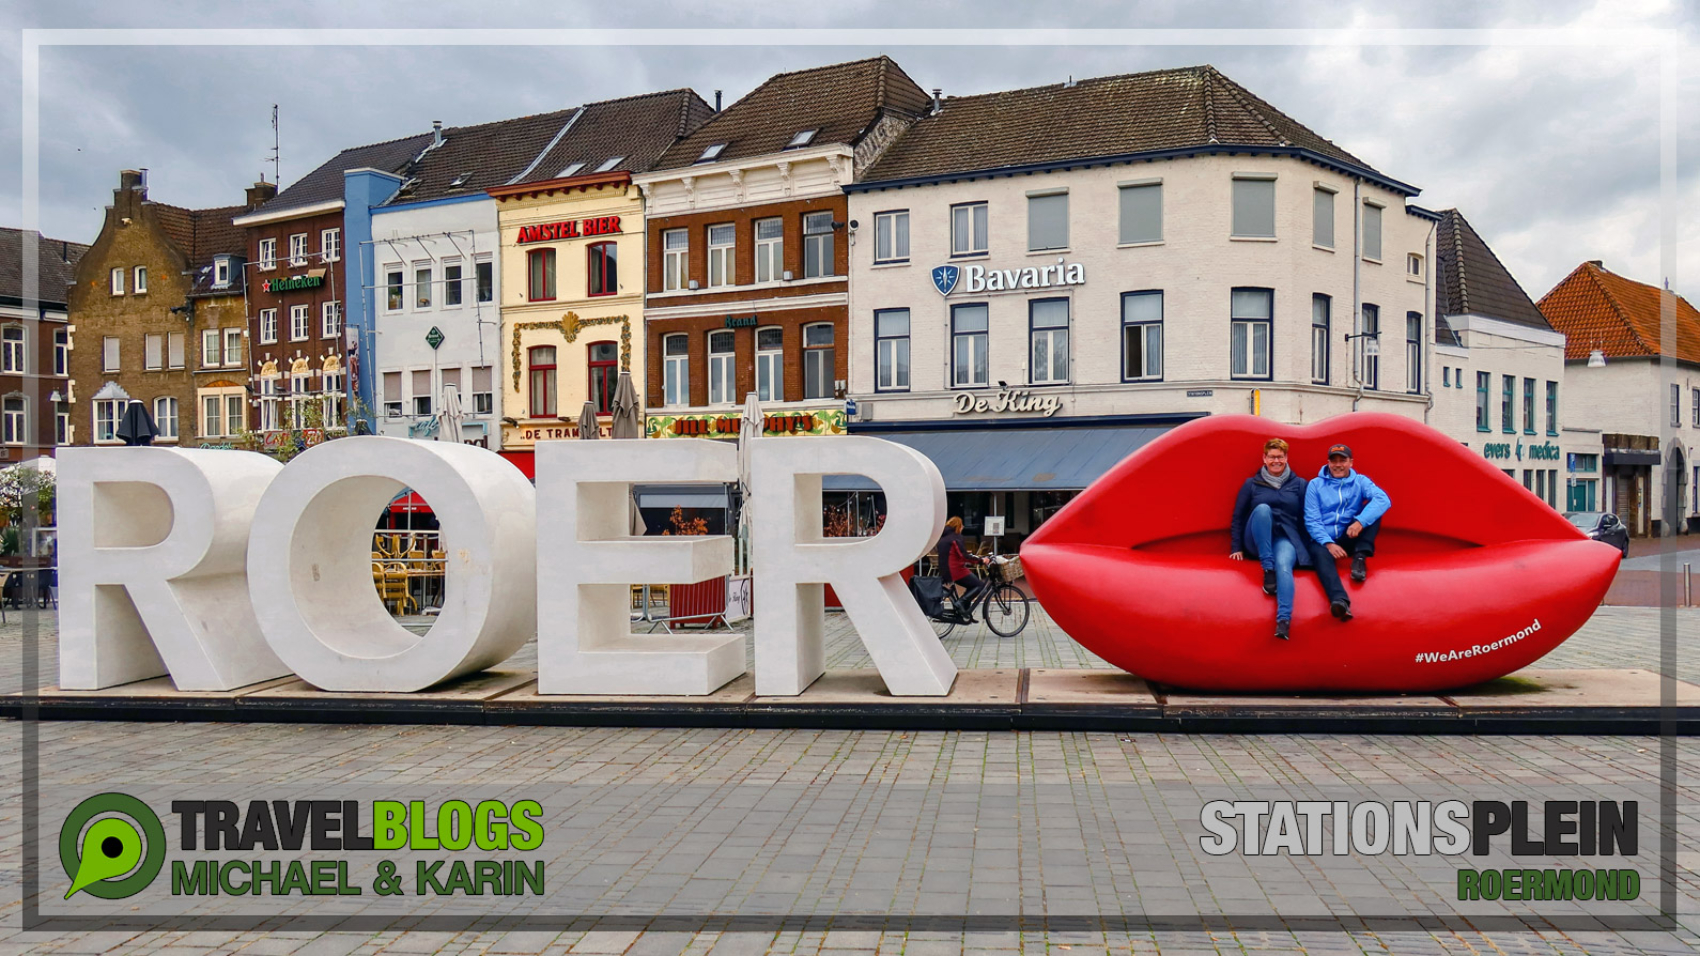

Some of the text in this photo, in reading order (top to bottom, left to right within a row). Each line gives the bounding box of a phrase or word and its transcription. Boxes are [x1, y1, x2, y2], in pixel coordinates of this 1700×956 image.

[516, 215, 623, 243] AMSTEL BIER
[271, 276, 320, 292] Heineken
[965, 257, 1085, 293] Bavaria
[953, 390, 1064, 417] De King
[675, 415, 812, 435] JILL MUHY'S
[1483, 440, 1560, 461] evers medica
[57, 434, 958, 697] ROER
[1415, 618, 1542, 663] #WeAreRoermond
